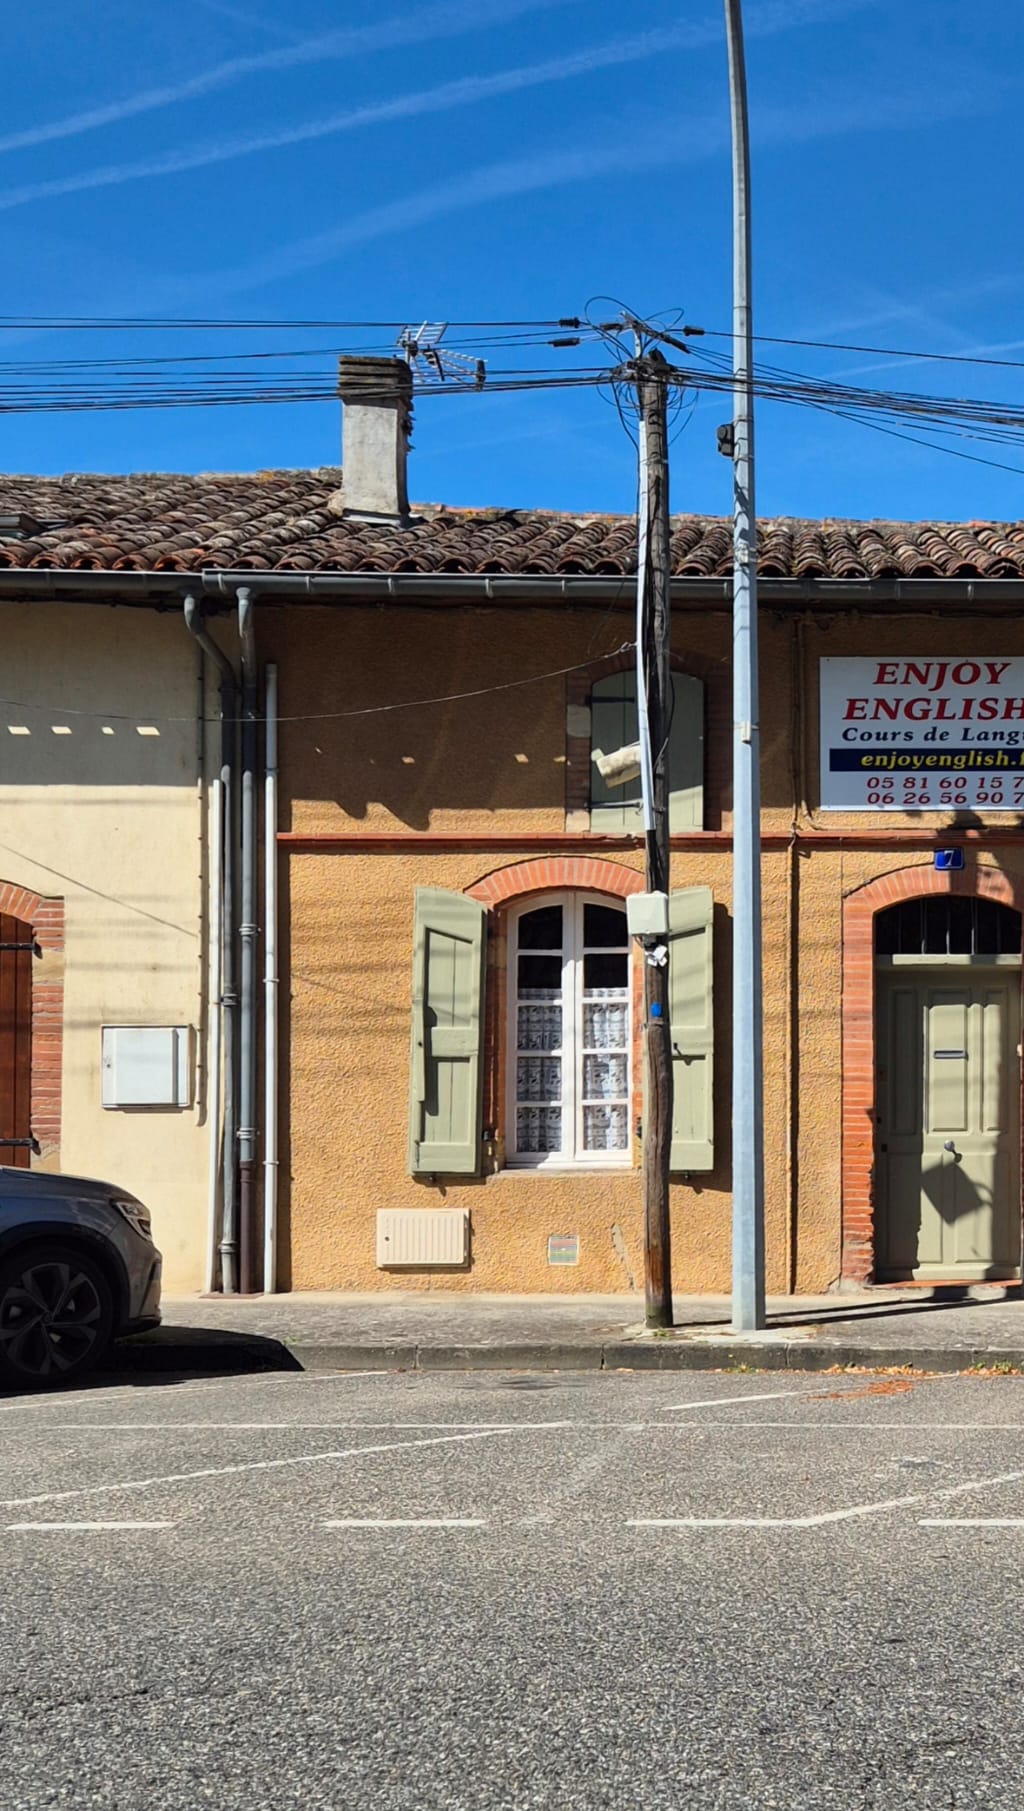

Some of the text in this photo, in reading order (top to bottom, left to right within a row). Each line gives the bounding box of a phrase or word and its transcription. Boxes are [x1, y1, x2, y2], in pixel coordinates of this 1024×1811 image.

[873, 662, 1011, 691] ENJOY
[842, 727, 914, 742] Cours
[923, 726, 949, 742] de
[867, 777, 894, 789] 05
[903, 777, 928, 789] 81
[939, 777, 967, 789] 60
[978, 777, 1003, 789] 15
[867, 792, 895, 805] 06
[903, 792, 931, 805] 26
[940, 792, 967, 805] 56
[976, 792, 1004, 805] 90
[943, 850, 954, 866] 7
